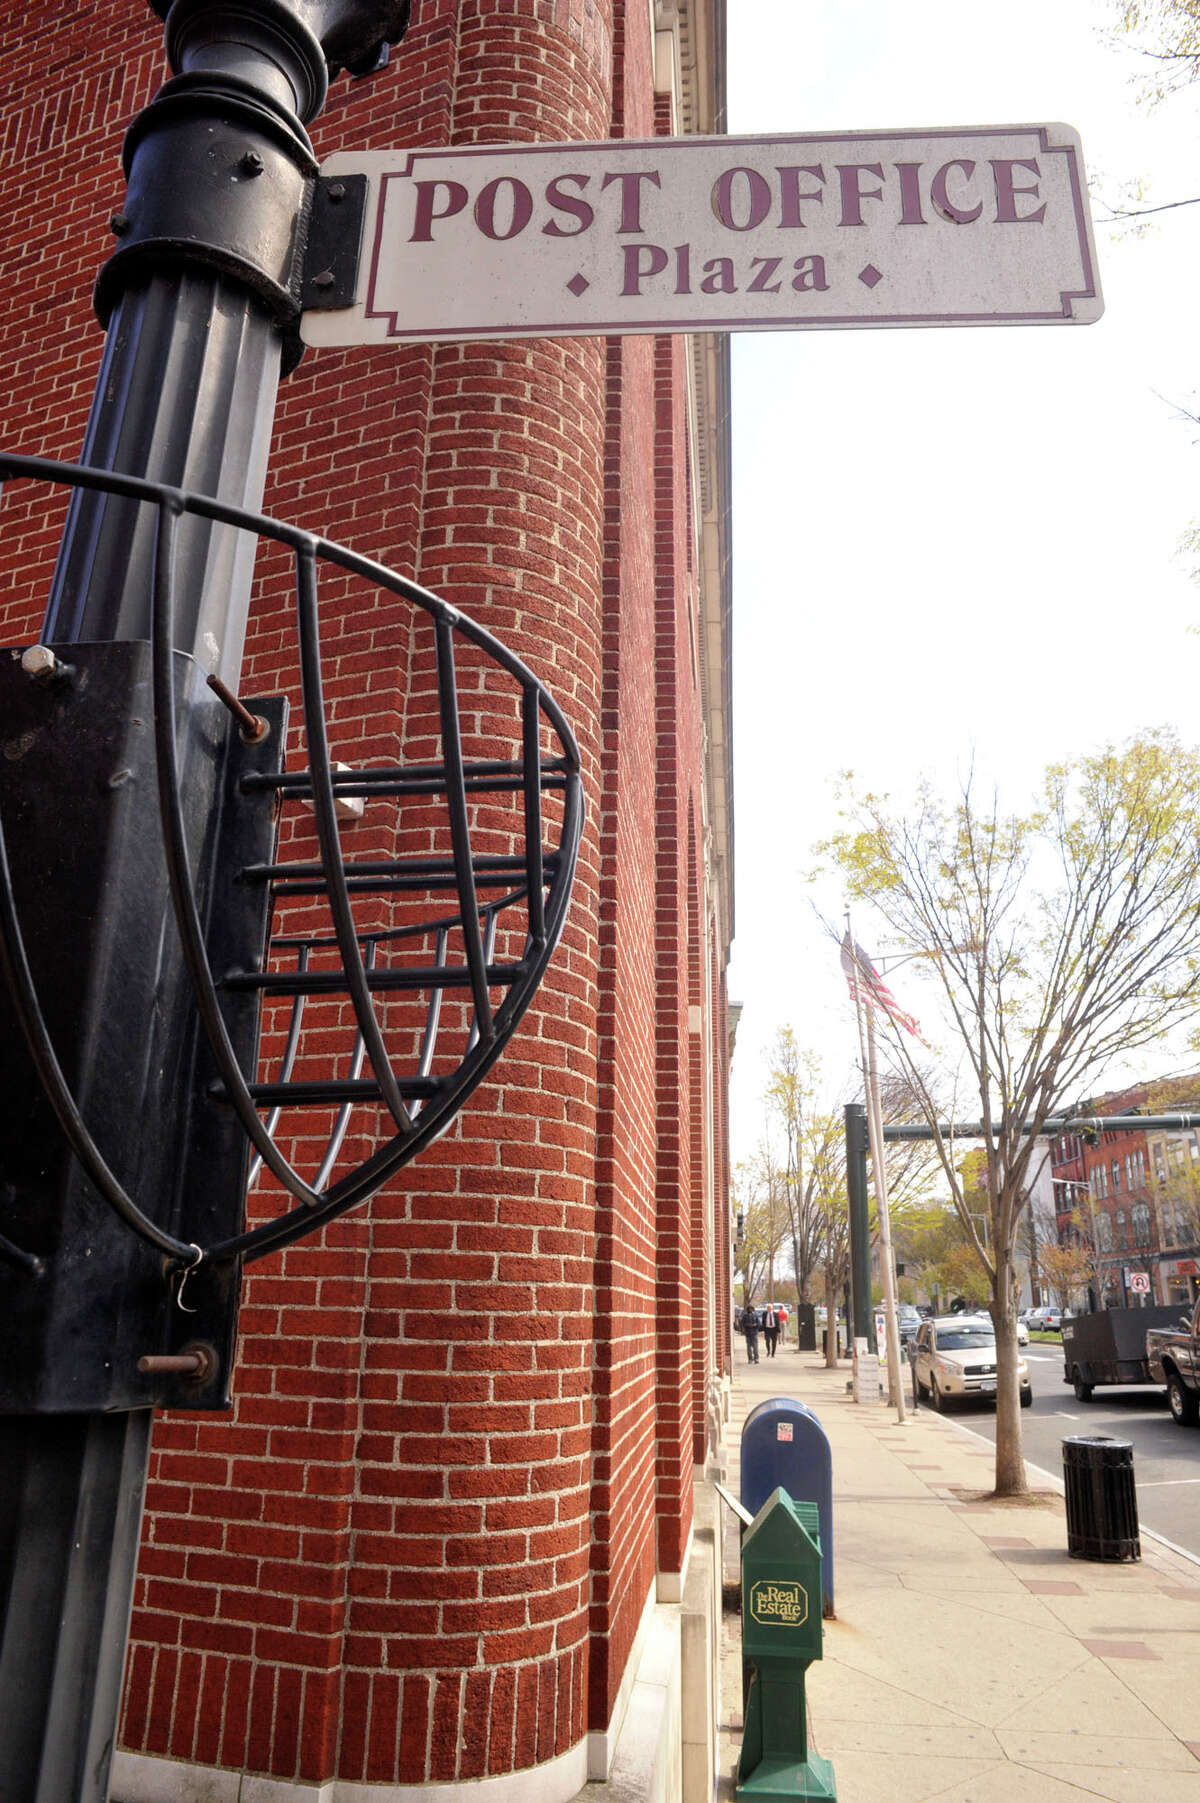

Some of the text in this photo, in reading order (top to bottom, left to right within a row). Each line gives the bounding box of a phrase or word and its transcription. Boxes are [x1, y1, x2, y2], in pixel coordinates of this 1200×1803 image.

[410, 158, 1047, 243] POST OFFICE
[618, 245, 831, 297] Plaza
[757, 1600, 800, 1616] Estate
[767, 1587, 798, 1603] Real
